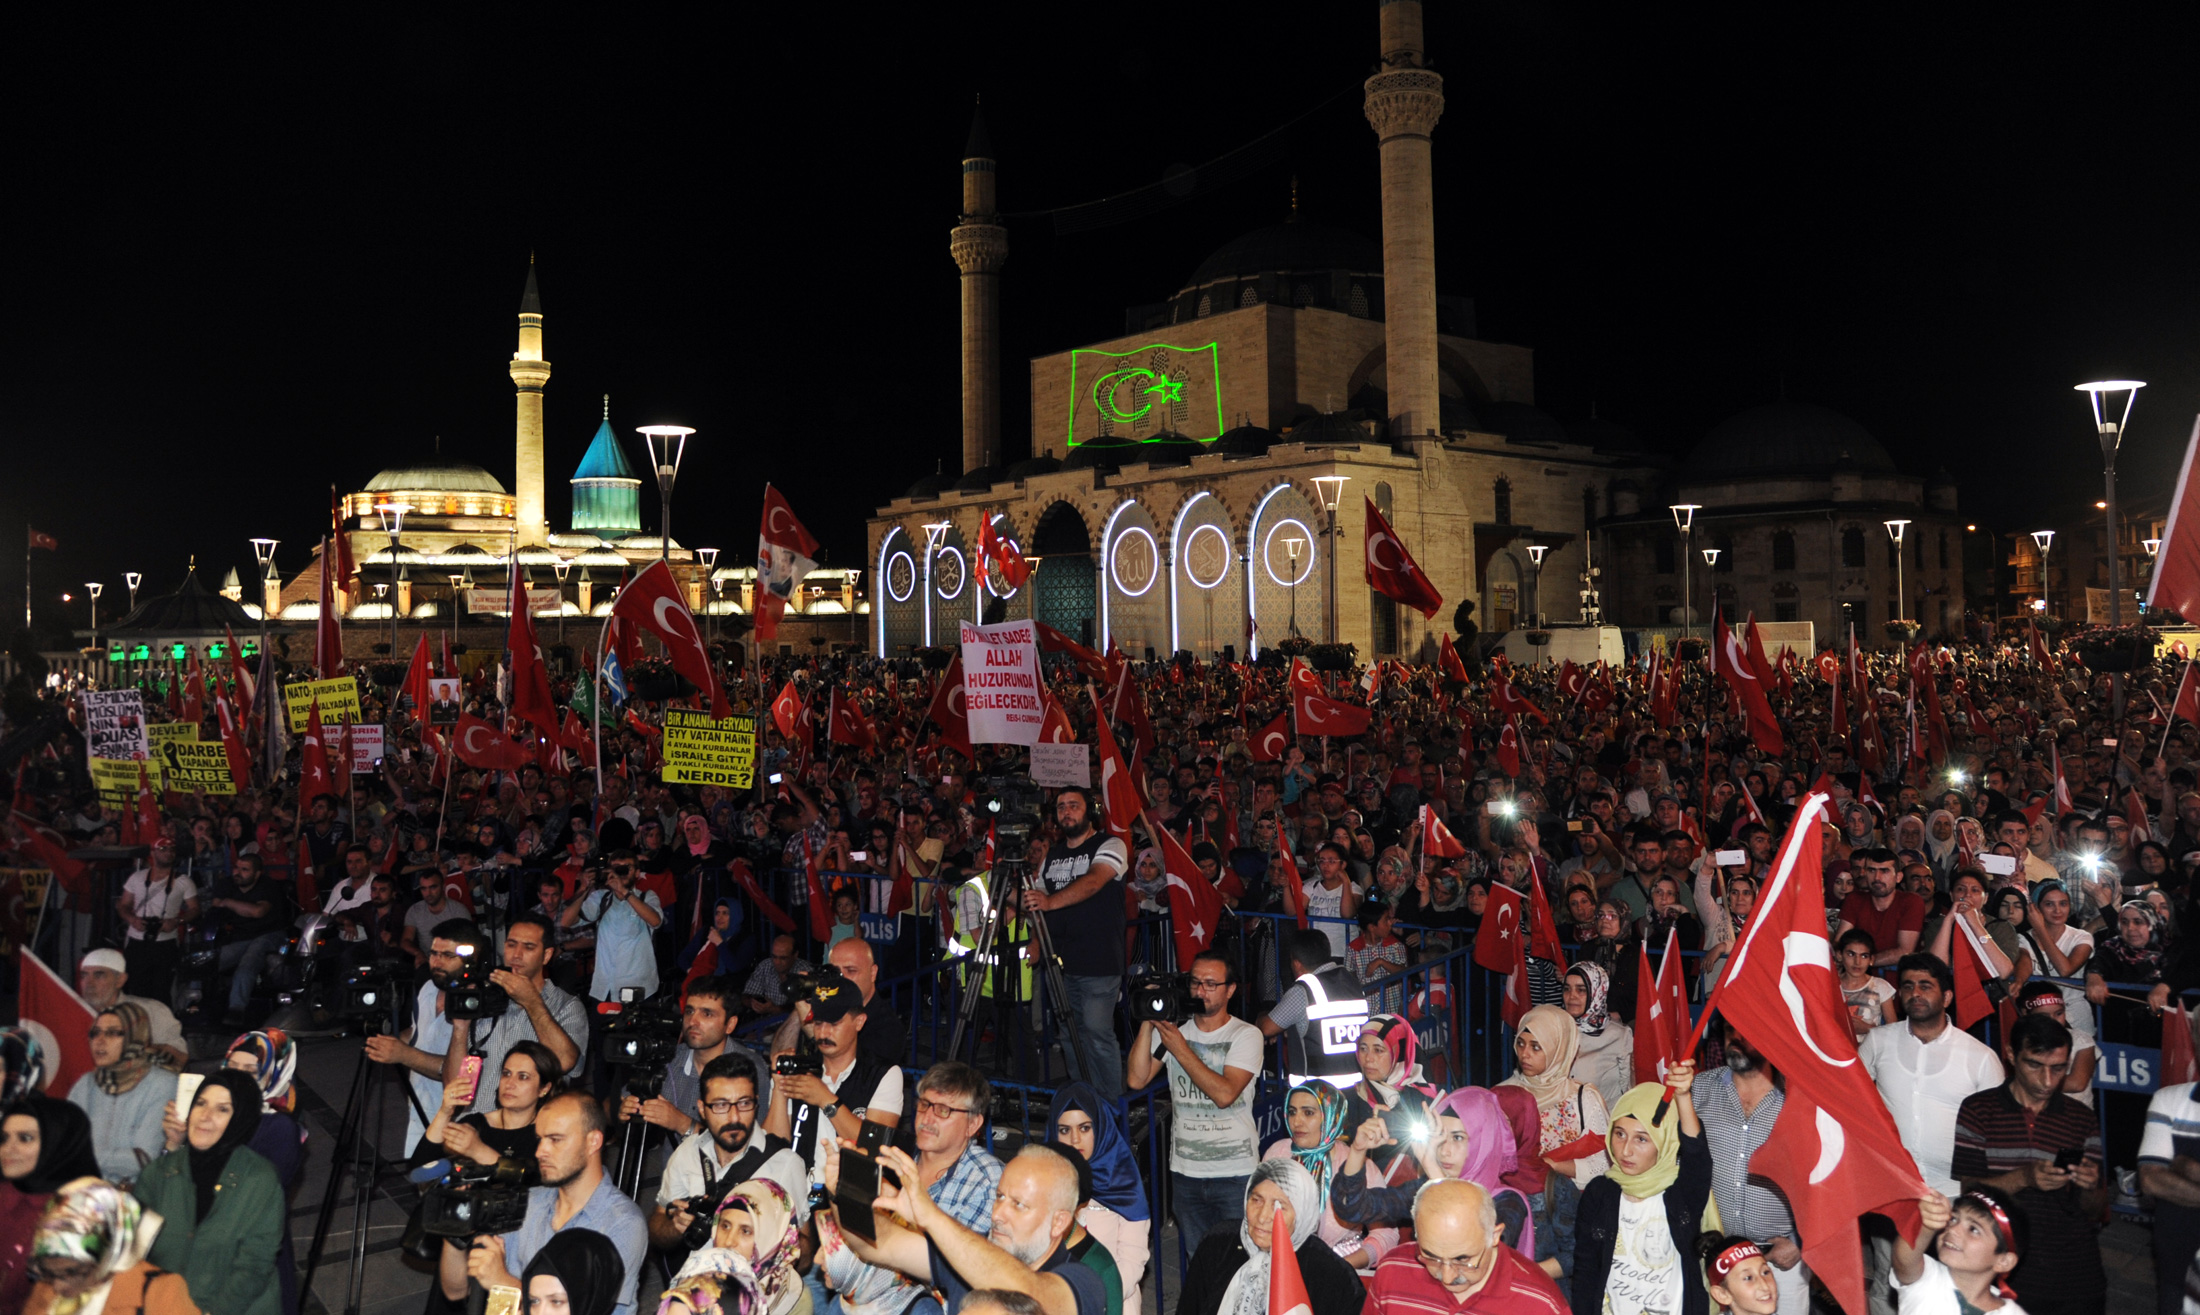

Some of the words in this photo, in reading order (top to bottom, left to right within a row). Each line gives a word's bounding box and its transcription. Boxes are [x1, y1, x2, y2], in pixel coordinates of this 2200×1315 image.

[962, 629, 975, 643] BU
[985, 650, 1023, 667] ALLAH
[968, 672, 1034, 689] HUZURUNDA
[324, 711, 359, 725] OLSN
[100, 728, 143, 743] DUASI
[149, 725, 192, 736] DEVLET
[668, 729, 687, 739] EYY
[690, 730, 721, 743] VATAN
[178, 744, 225, 757] DARBE
[673, 742, 700, 750] AYAKLI
[702, 744, 751, 754] KURBANLAR
[181, 758, 228, 767] YAPANLAR
[702, 762, 751, 772] KURBANLAR
[168, 768, 231, 781] DARBE
[677, 769, 751, 786] NERDE?
[860, 918, 894, 940] OLİS
[2099, 1050, 2151, 1086] LİS
[1257, 1104, 1282, 1141] LİS
[1611, 1258, 1673, 1285] Model
[1612, 1278, 1664, 1307] Wall
